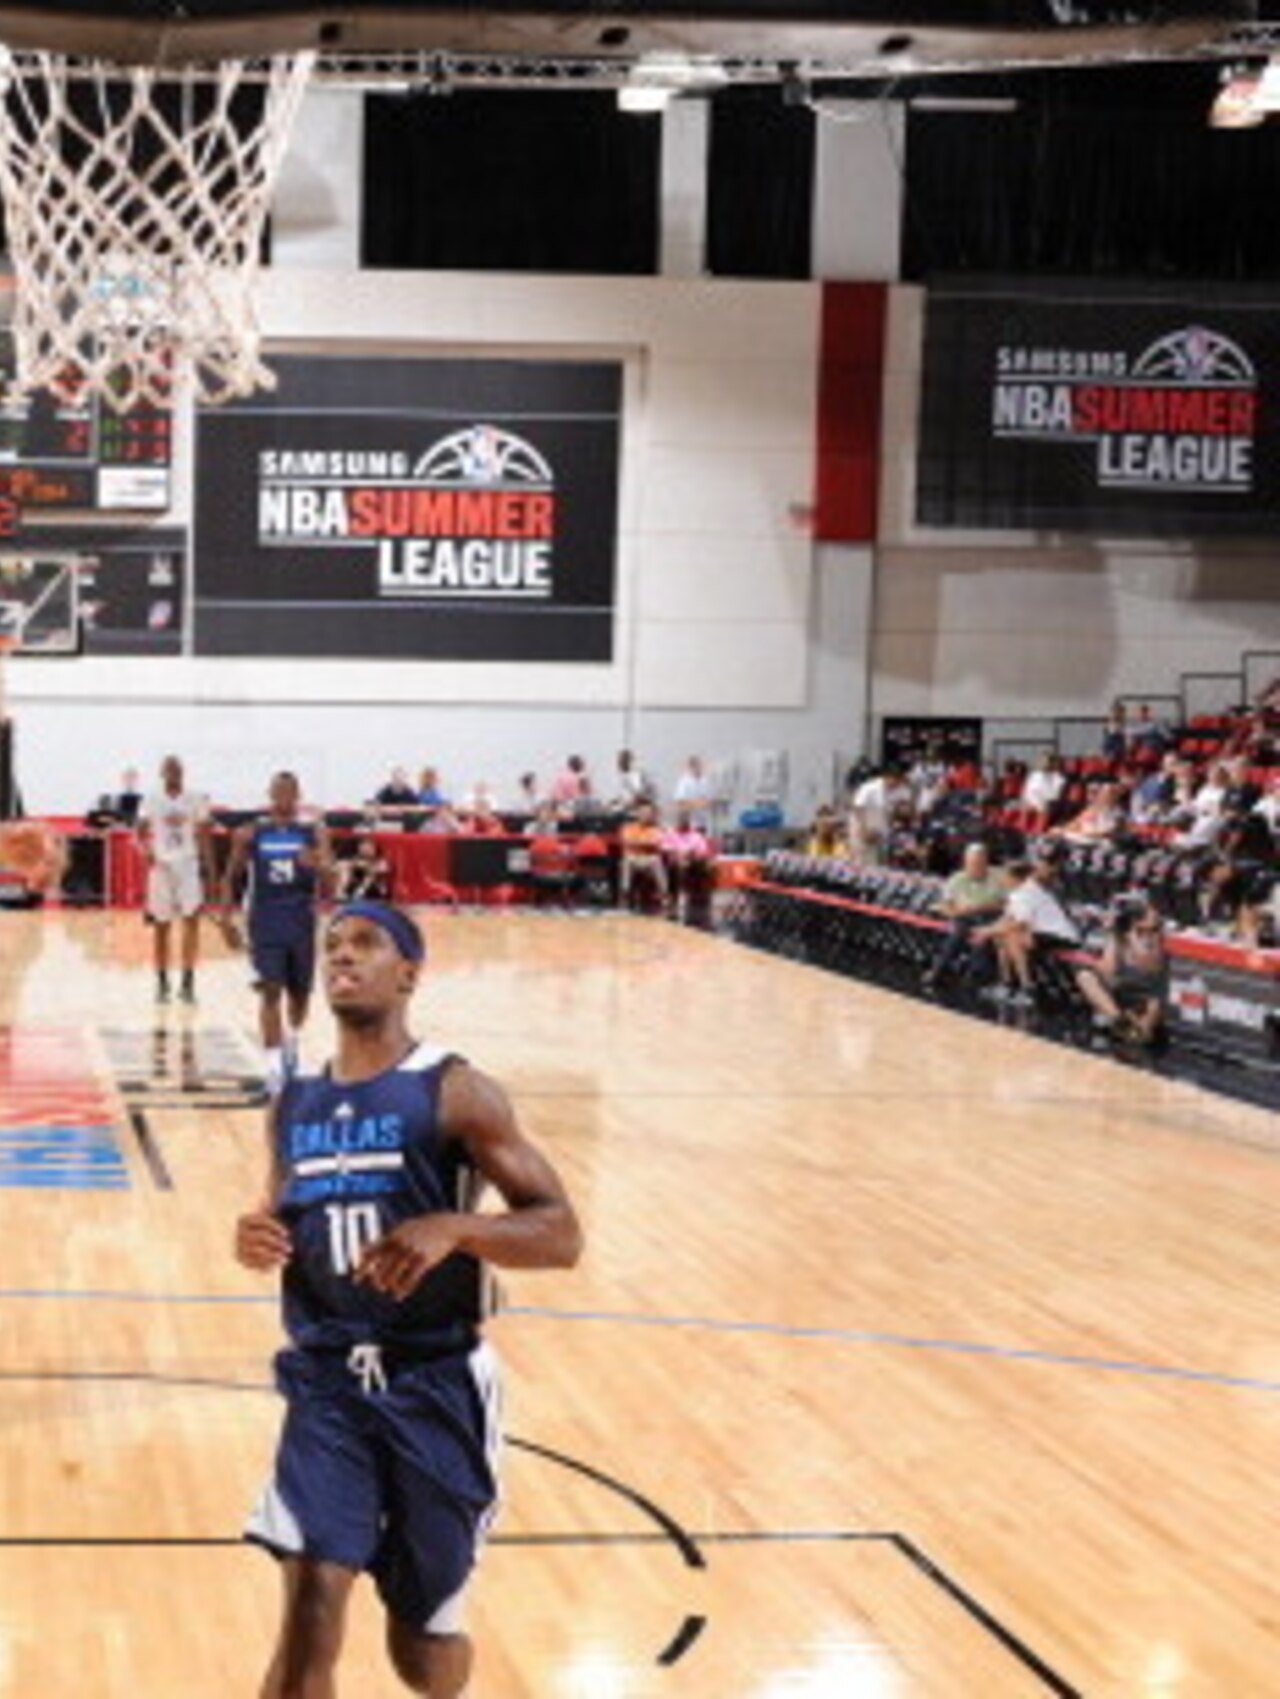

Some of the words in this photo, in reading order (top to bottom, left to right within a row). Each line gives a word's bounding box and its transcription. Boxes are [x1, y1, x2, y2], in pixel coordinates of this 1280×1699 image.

[993, 385, 1072, 427] NBA
[1073, 386, 1256, 437] SUMMER
[260, 452, 409, 476] SAMSUNG
[1098, 435, 1253, 481] LEAGUE
[259, 490, 348, 535] NBA
[349, 491, 553, 538] SUMMER
[380, 541, 551, 586] LEAGUE
[290, 1113, 401, 1157] DALLAS
[325, 1203, 382, 1275] 10
